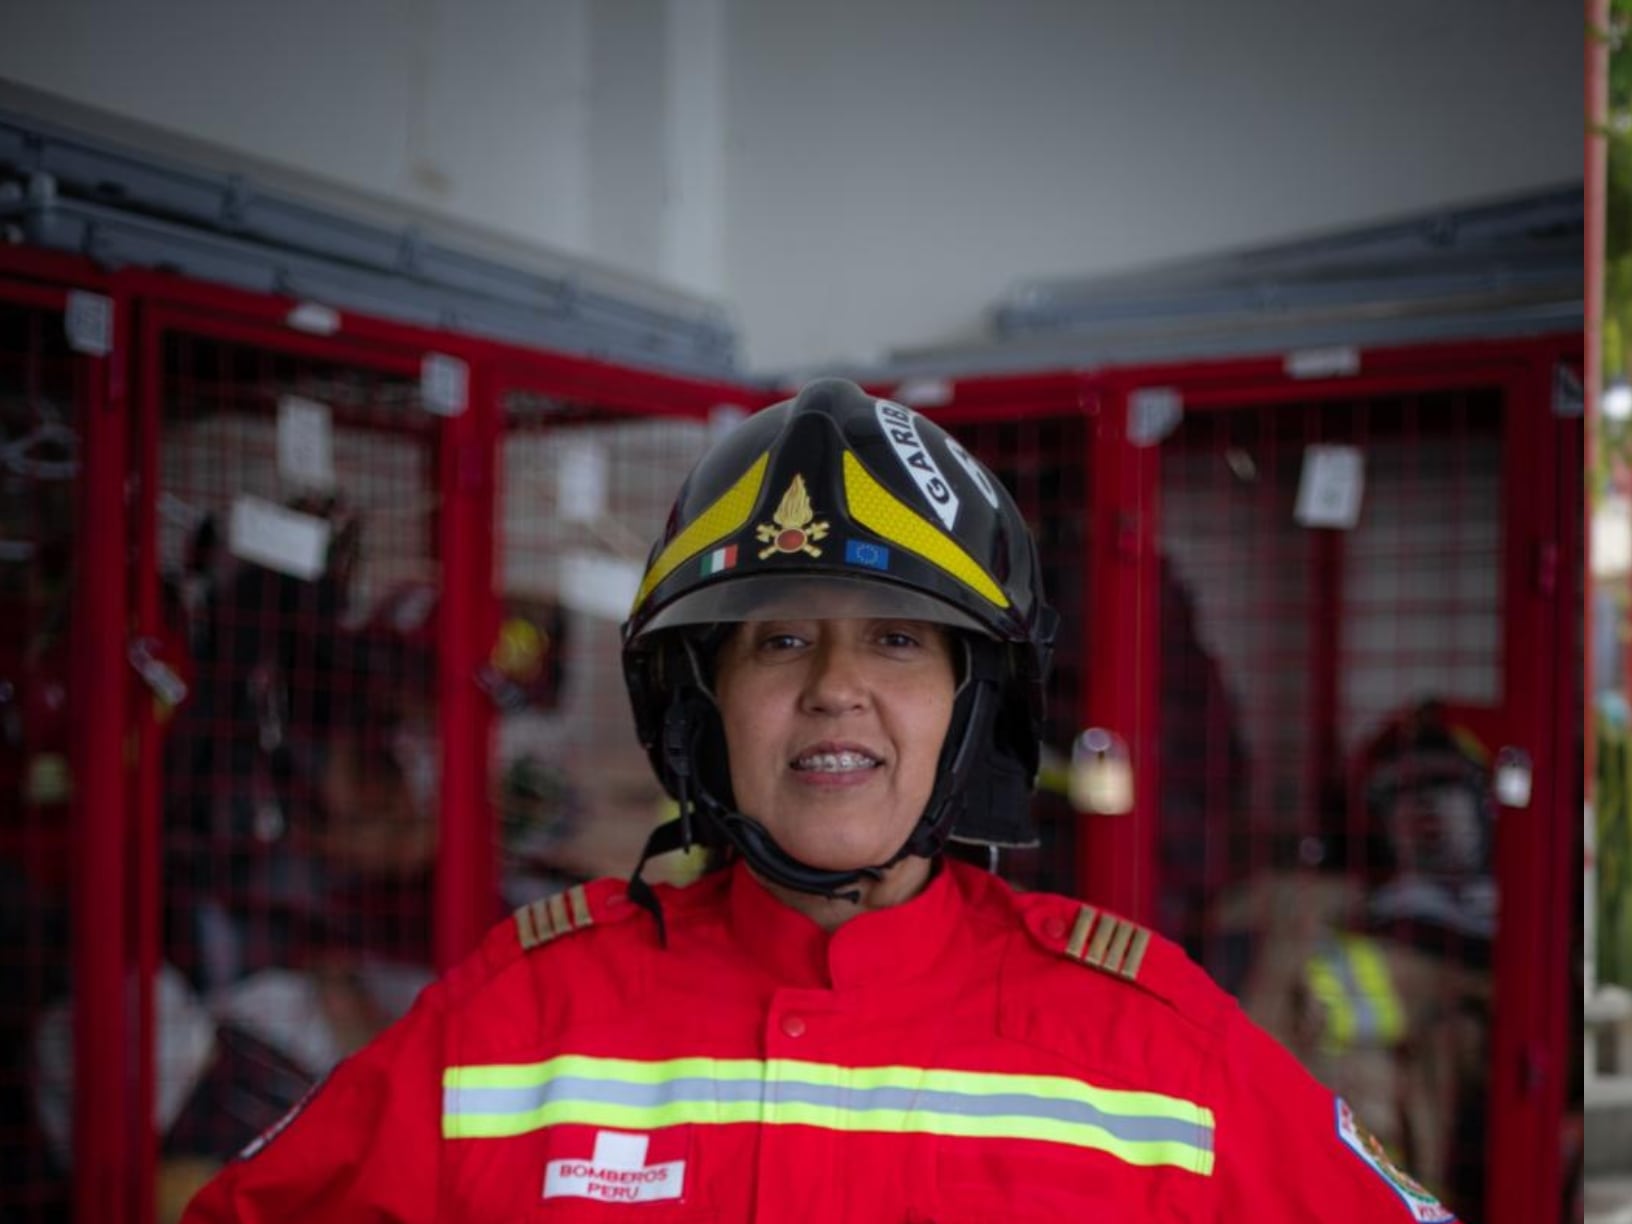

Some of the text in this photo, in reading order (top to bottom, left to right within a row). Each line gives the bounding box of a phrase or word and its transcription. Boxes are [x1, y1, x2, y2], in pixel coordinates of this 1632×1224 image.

[882, 405, 950, 505] GARIB
[559, 1164, 668, 1183] BOMBEROS
[587, 1182, 639, 1200] PERU
